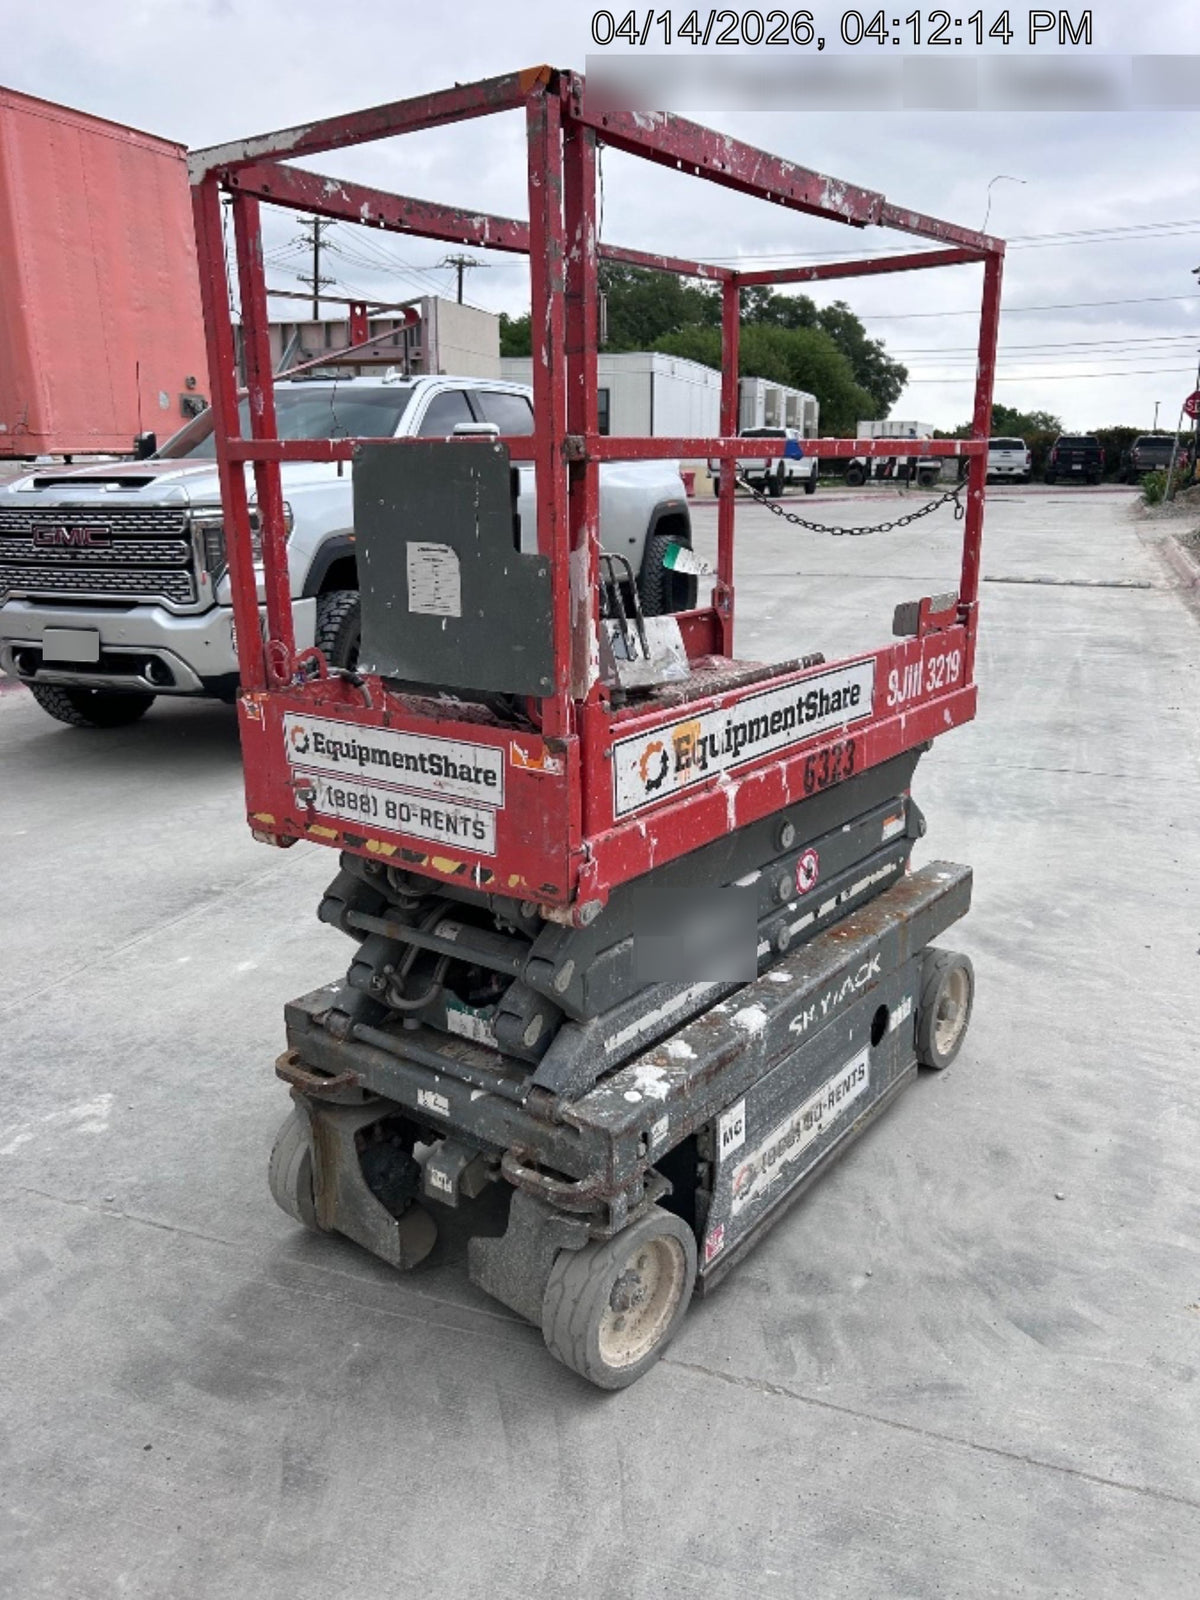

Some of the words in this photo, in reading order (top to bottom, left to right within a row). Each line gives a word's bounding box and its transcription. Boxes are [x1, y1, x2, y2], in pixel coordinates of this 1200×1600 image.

[33, 526, 111, 546] GMC
[926, 649, 960, 692] 3219
[673, 683, 861, 772] EquipmentShare
[312, 732, 497, 787] EquipmentShare
[327, 785, 379, 817] (888)
[385, 801, 486, 840] 80-RENTS
